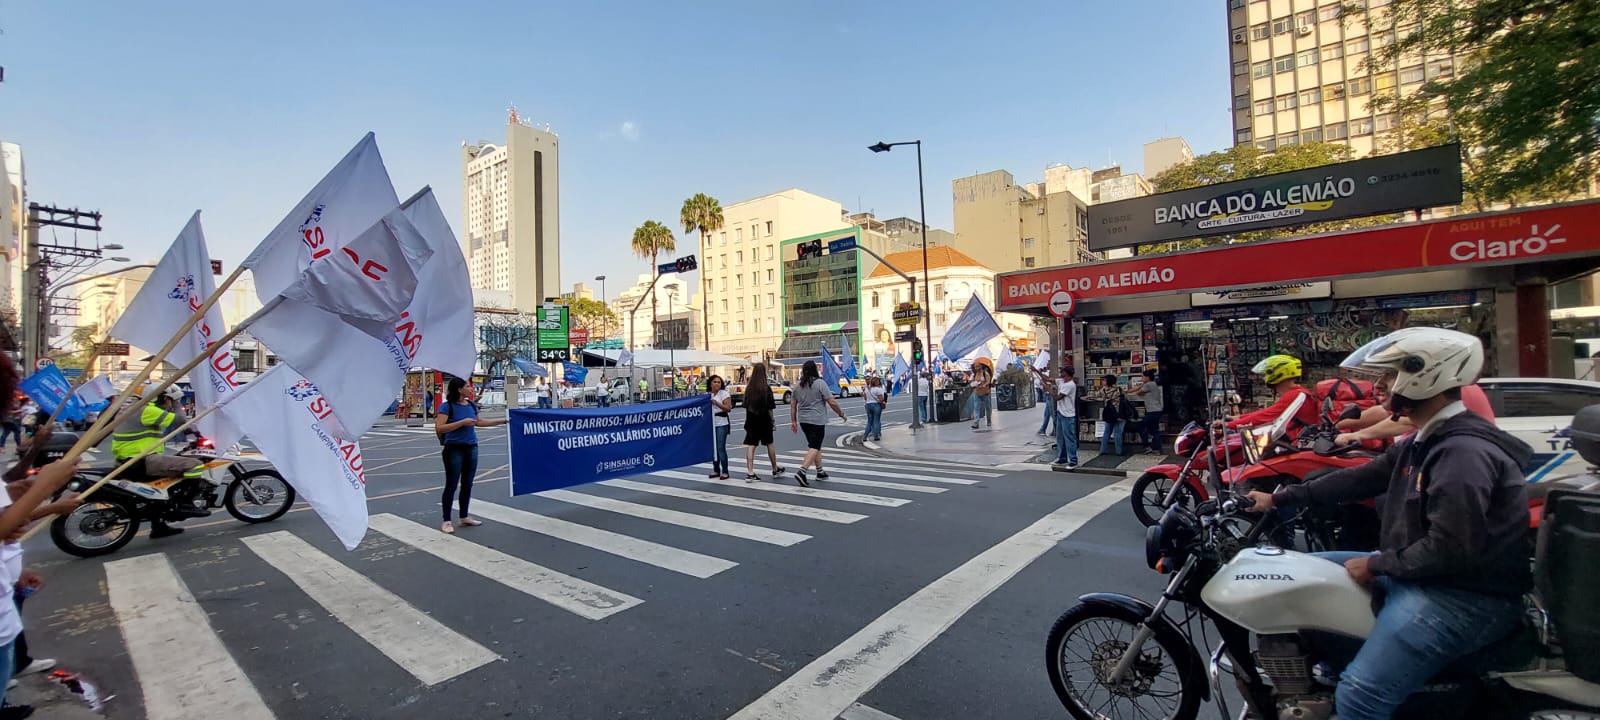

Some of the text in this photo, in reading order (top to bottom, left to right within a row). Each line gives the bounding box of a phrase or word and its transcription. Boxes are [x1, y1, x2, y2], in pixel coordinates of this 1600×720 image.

[1155, 176, 1355, 224] BANCA DO ALEMÃO
[1102, 214, 1132, 225] DESDE
[1200, 208, 1300, 228] ARTE CULTURA LAZER
[1450, 216, 1521, 233] AQUI TEM
[1450, 234, 1549, 261] Claro
[1008, 267, 1175, 298] BANCA DO ALEMÃO
[541, 350, 566, 360] 34°C
[523, 406, 704, 435] MINISTRO BARROSO: MAIS QUE APLAUSOS,
[557, 424, 683, 451] QUEREMOS SALÁRIOS DIGNOS
[1546, 440, 1576, 451] TA
[603, 456, 641, 470] SINSAÚDE
